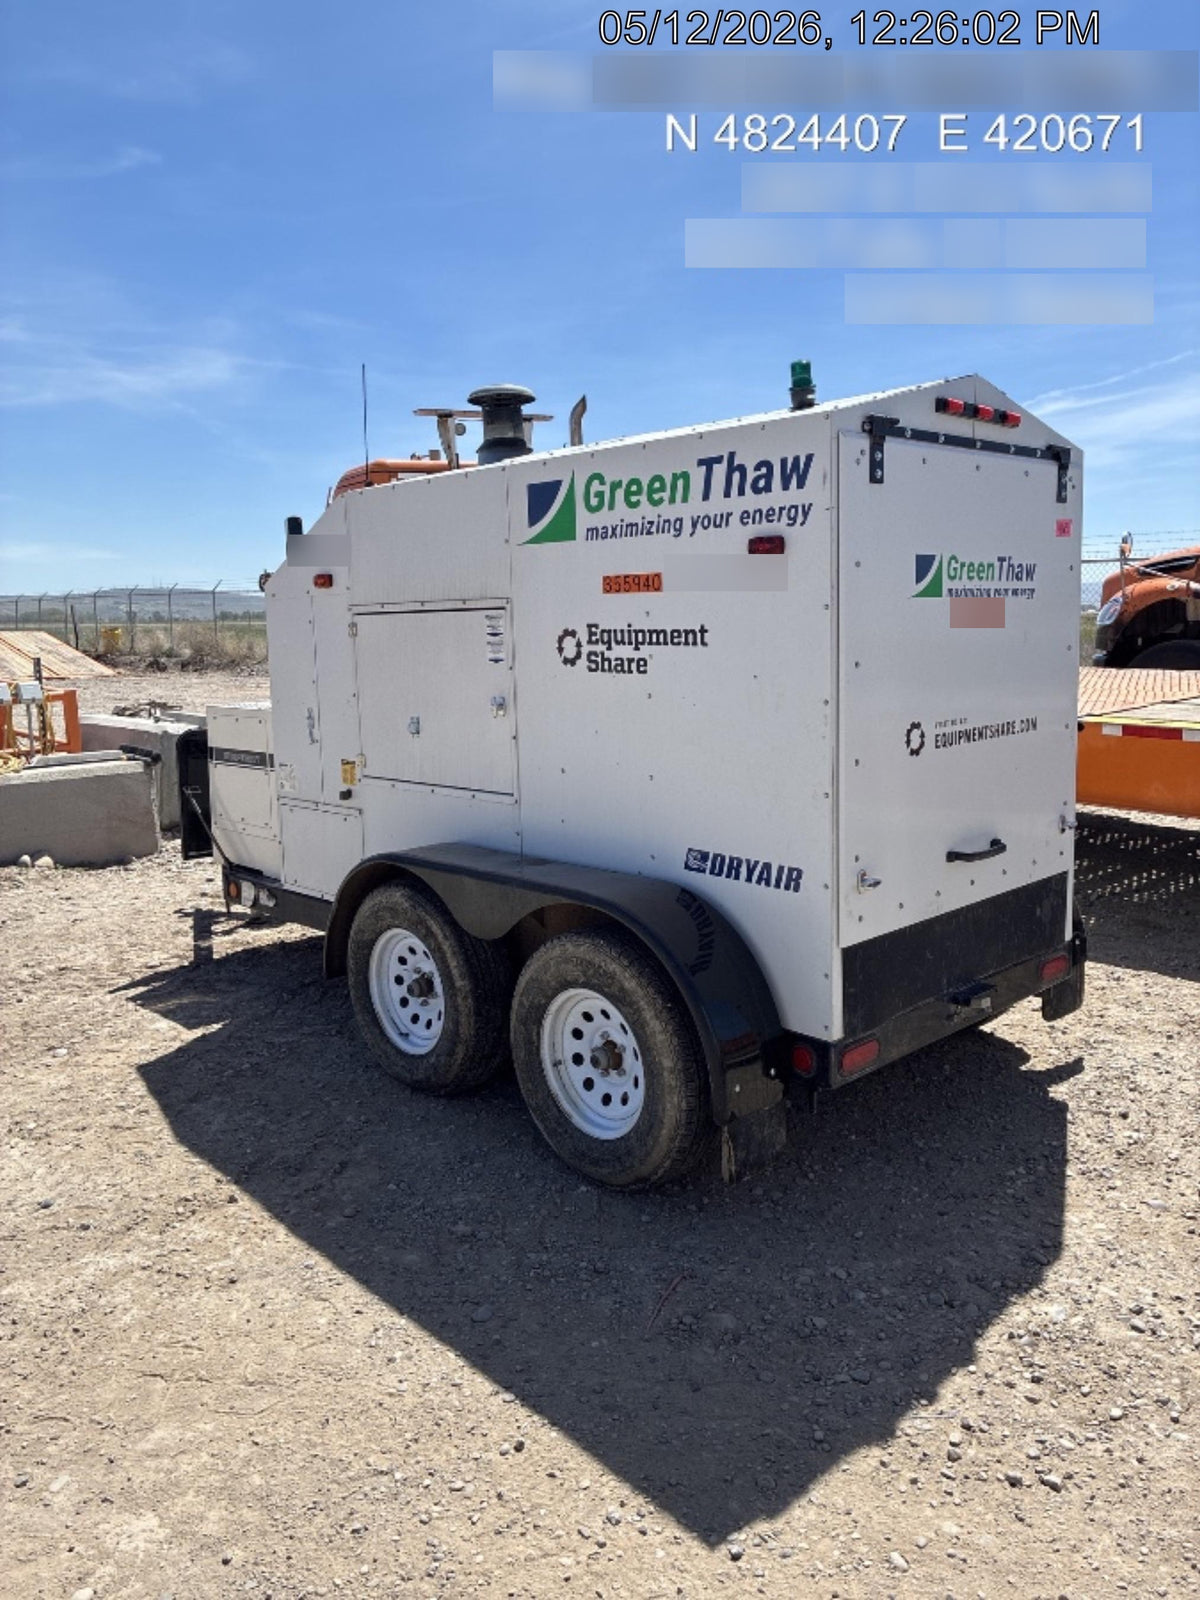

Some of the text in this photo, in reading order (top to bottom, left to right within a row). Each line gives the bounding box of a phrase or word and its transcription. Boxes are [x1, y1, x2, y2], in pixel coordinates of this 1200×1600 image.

[585, 502, 814, 542] maximizing your energy
[604, 573, 661, 593] 355940
[586, 623, 709, 651] Equipment
[586, 651, 648, 674] Share
[708, 852, 804, 893] DRYAIR
